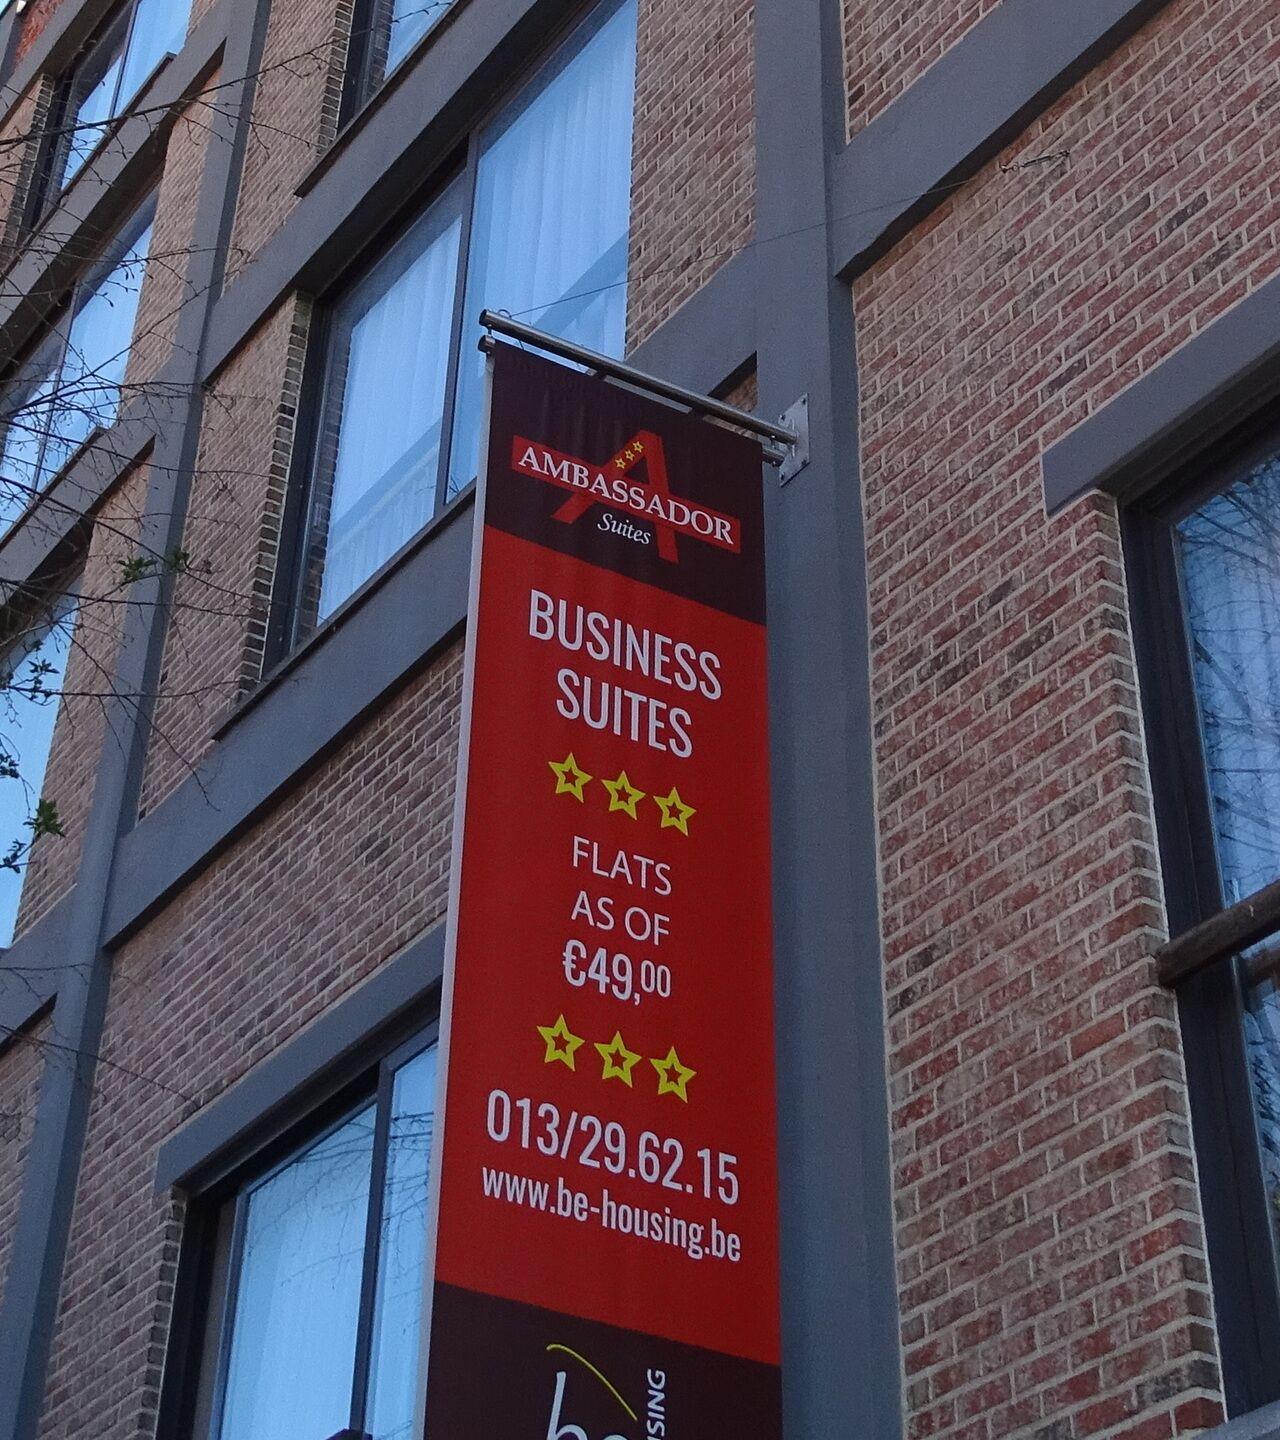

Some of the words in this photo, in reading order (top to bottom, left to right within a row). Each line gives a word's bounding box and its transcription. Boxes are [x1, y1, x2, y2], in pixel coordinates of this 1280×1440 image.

[518, 446, 734, 545] AMBASSADOR
[597, 513, 651, 545] Suites
[529, 589, 721, 700] BUSINESS
[556, 668, 692, 758] SUITES
[572, 835, 672, 895] FLATS
[571, 891, 615, 931] AS
[624, 906, 670, 946] OF
[562, 939, 671, 1006] €49,00
[487, 1089, 739, 1205] 013/29.62.15
[482, 1166, 741, 1262] www.be-housing.be
[546, 1371, 629, 1440] b
[646, 1368, 666, 1440] SING
